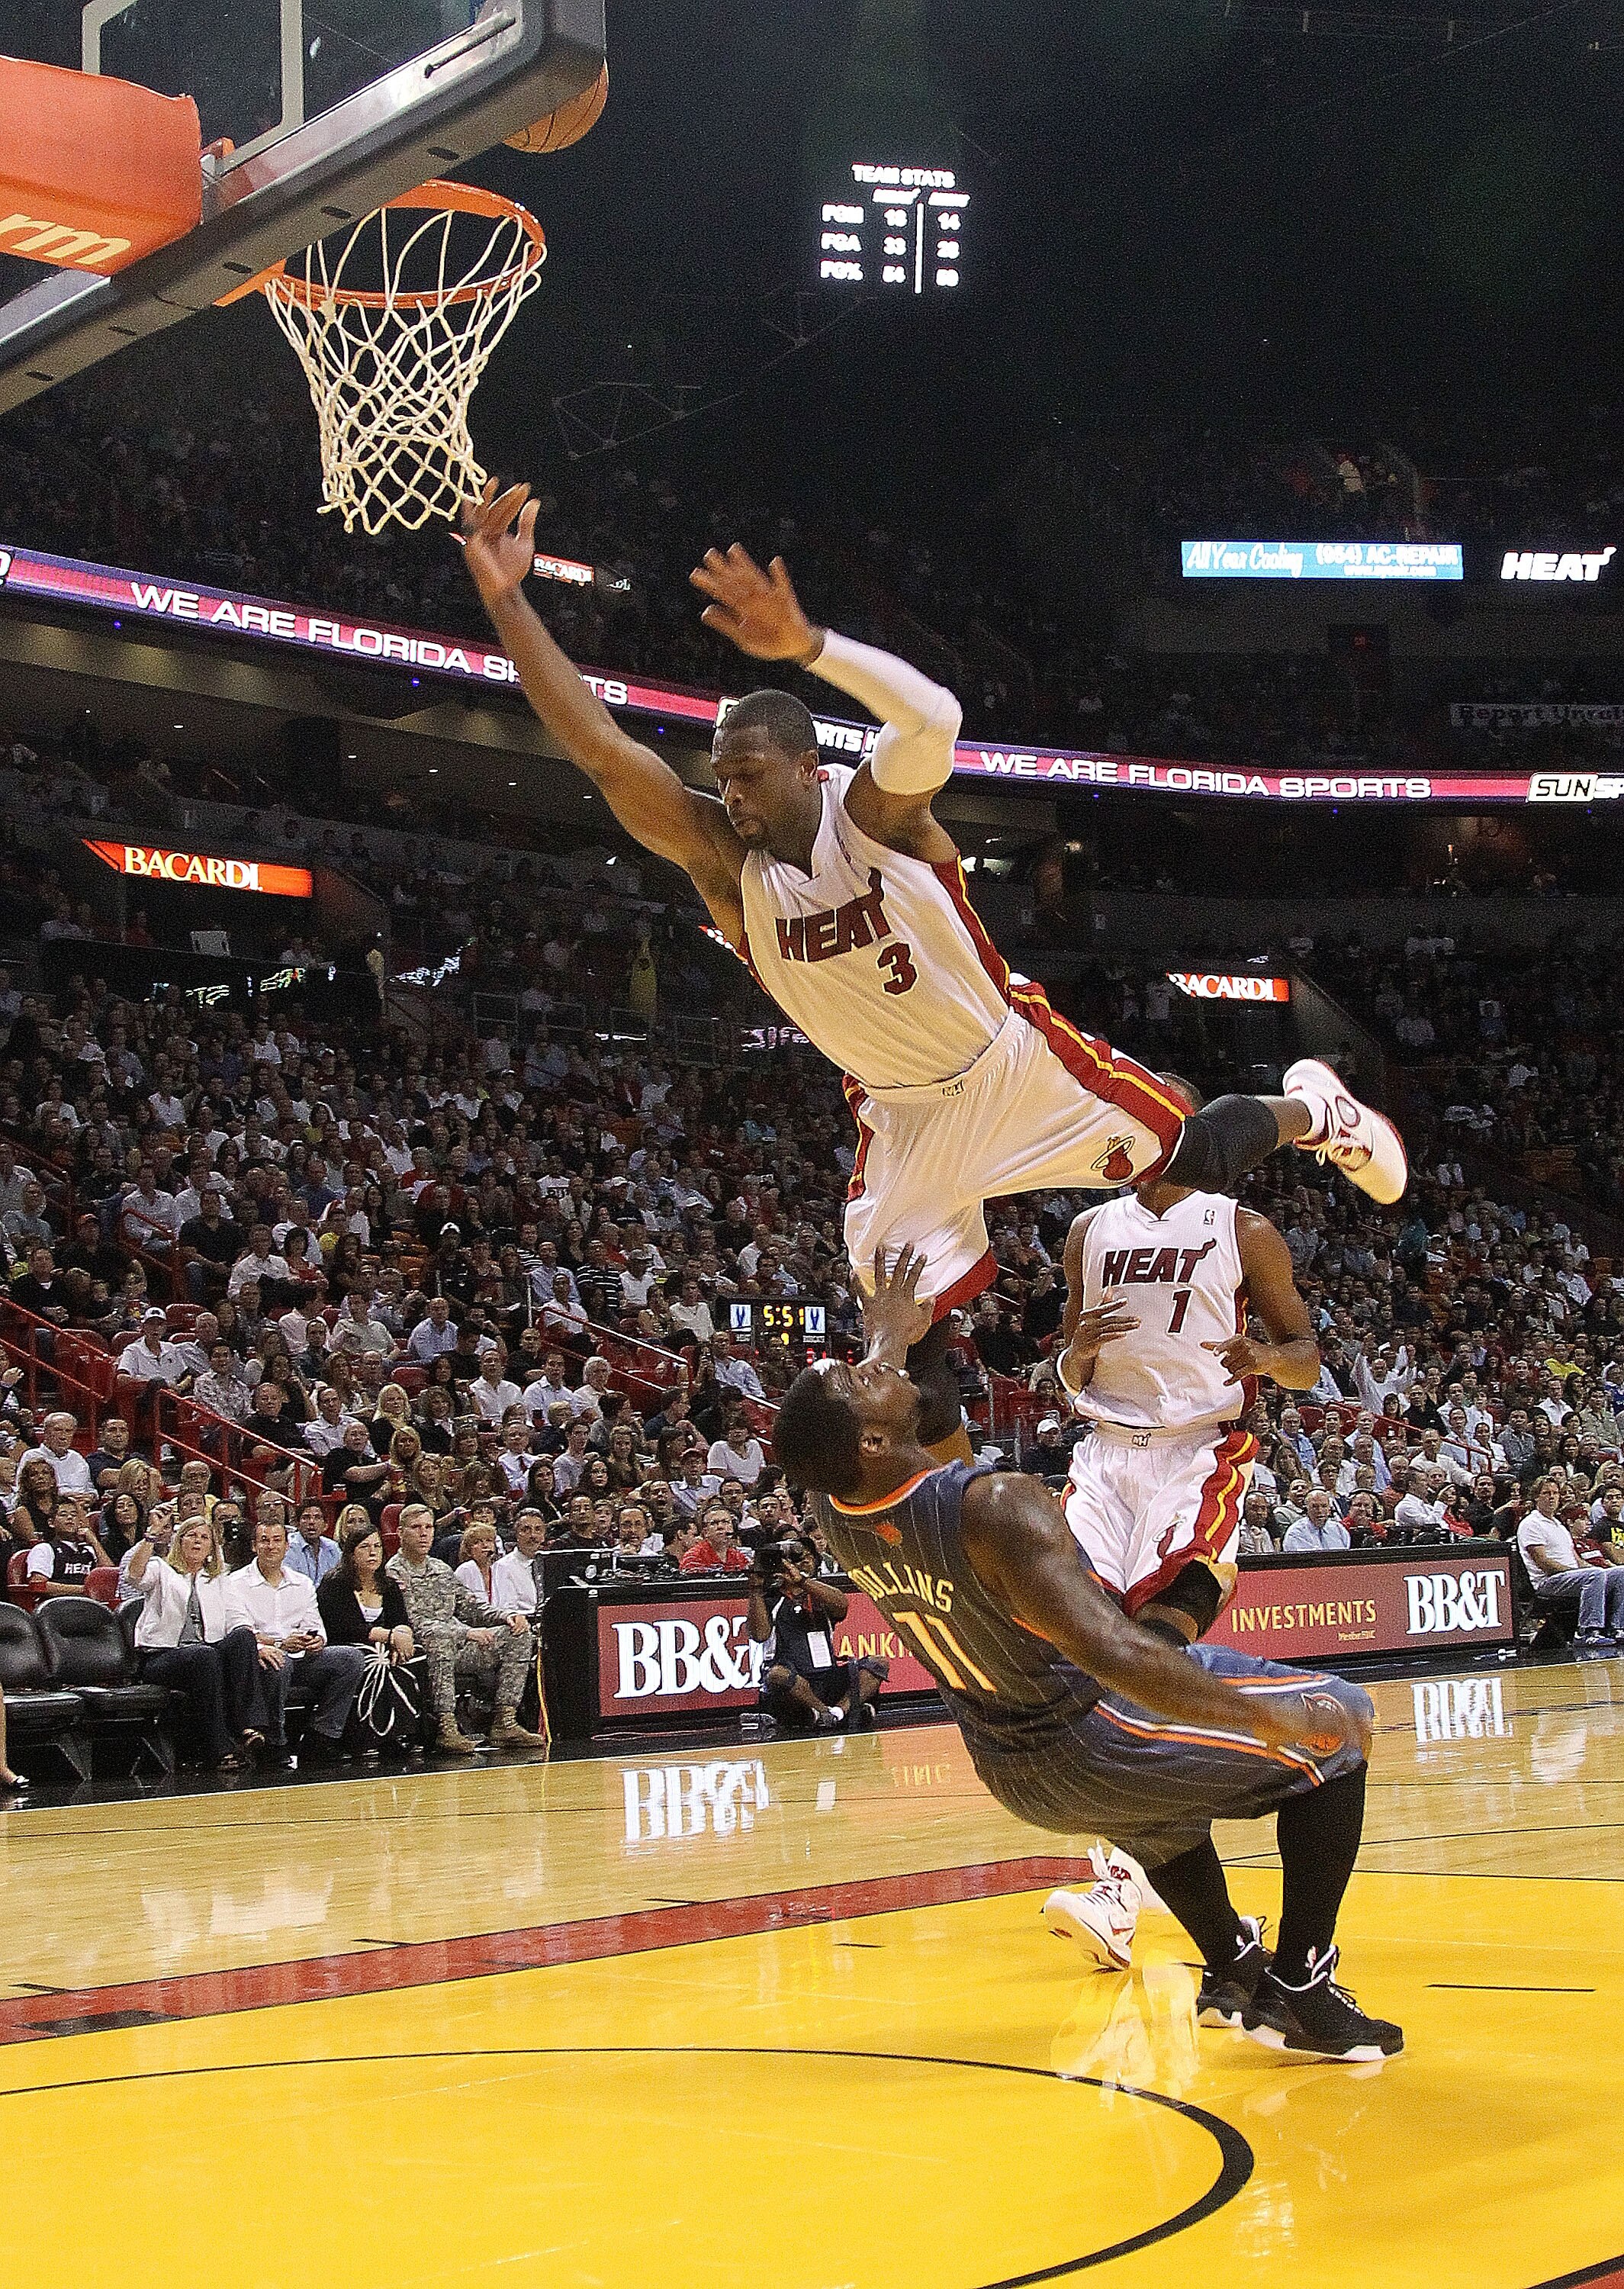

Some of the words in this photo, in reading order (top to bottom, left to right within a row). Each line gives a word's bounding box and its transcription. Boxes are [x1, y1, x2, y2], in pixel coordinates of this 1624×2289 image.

[851, 163, 900, 184] TEAM
[900, 167, 957, 188] STATS
[1186, 542, 1211, 569] All
[1500, 546, 1617, 582] HEAT
[130, 581, 199, 619] WE
[211, 600, 297, 639] ARE
[307, 617, 471, 673] FLORIDA
[980, 751, 1037, 777] WE
[1047, 758, 1118, 784] ARE
[1129, 764, 1269, 797] FLORIDA
[1279, 777, 1431, 799] SPORTS
[1535, 777, 1592, 797] SUN
[776, 867, 892, 962] HEAT
[877, 942, 918, 995] 3
[1102, 1238, 1217, 1289] HEAT
[1167, 1289, 1192, 1334] 1
[1231, 1599, 1377, 1633] INVESTMENTS
[1403, 1569, 1506, 1635] BB&T
[892, 1611, 997, 1693] 11
